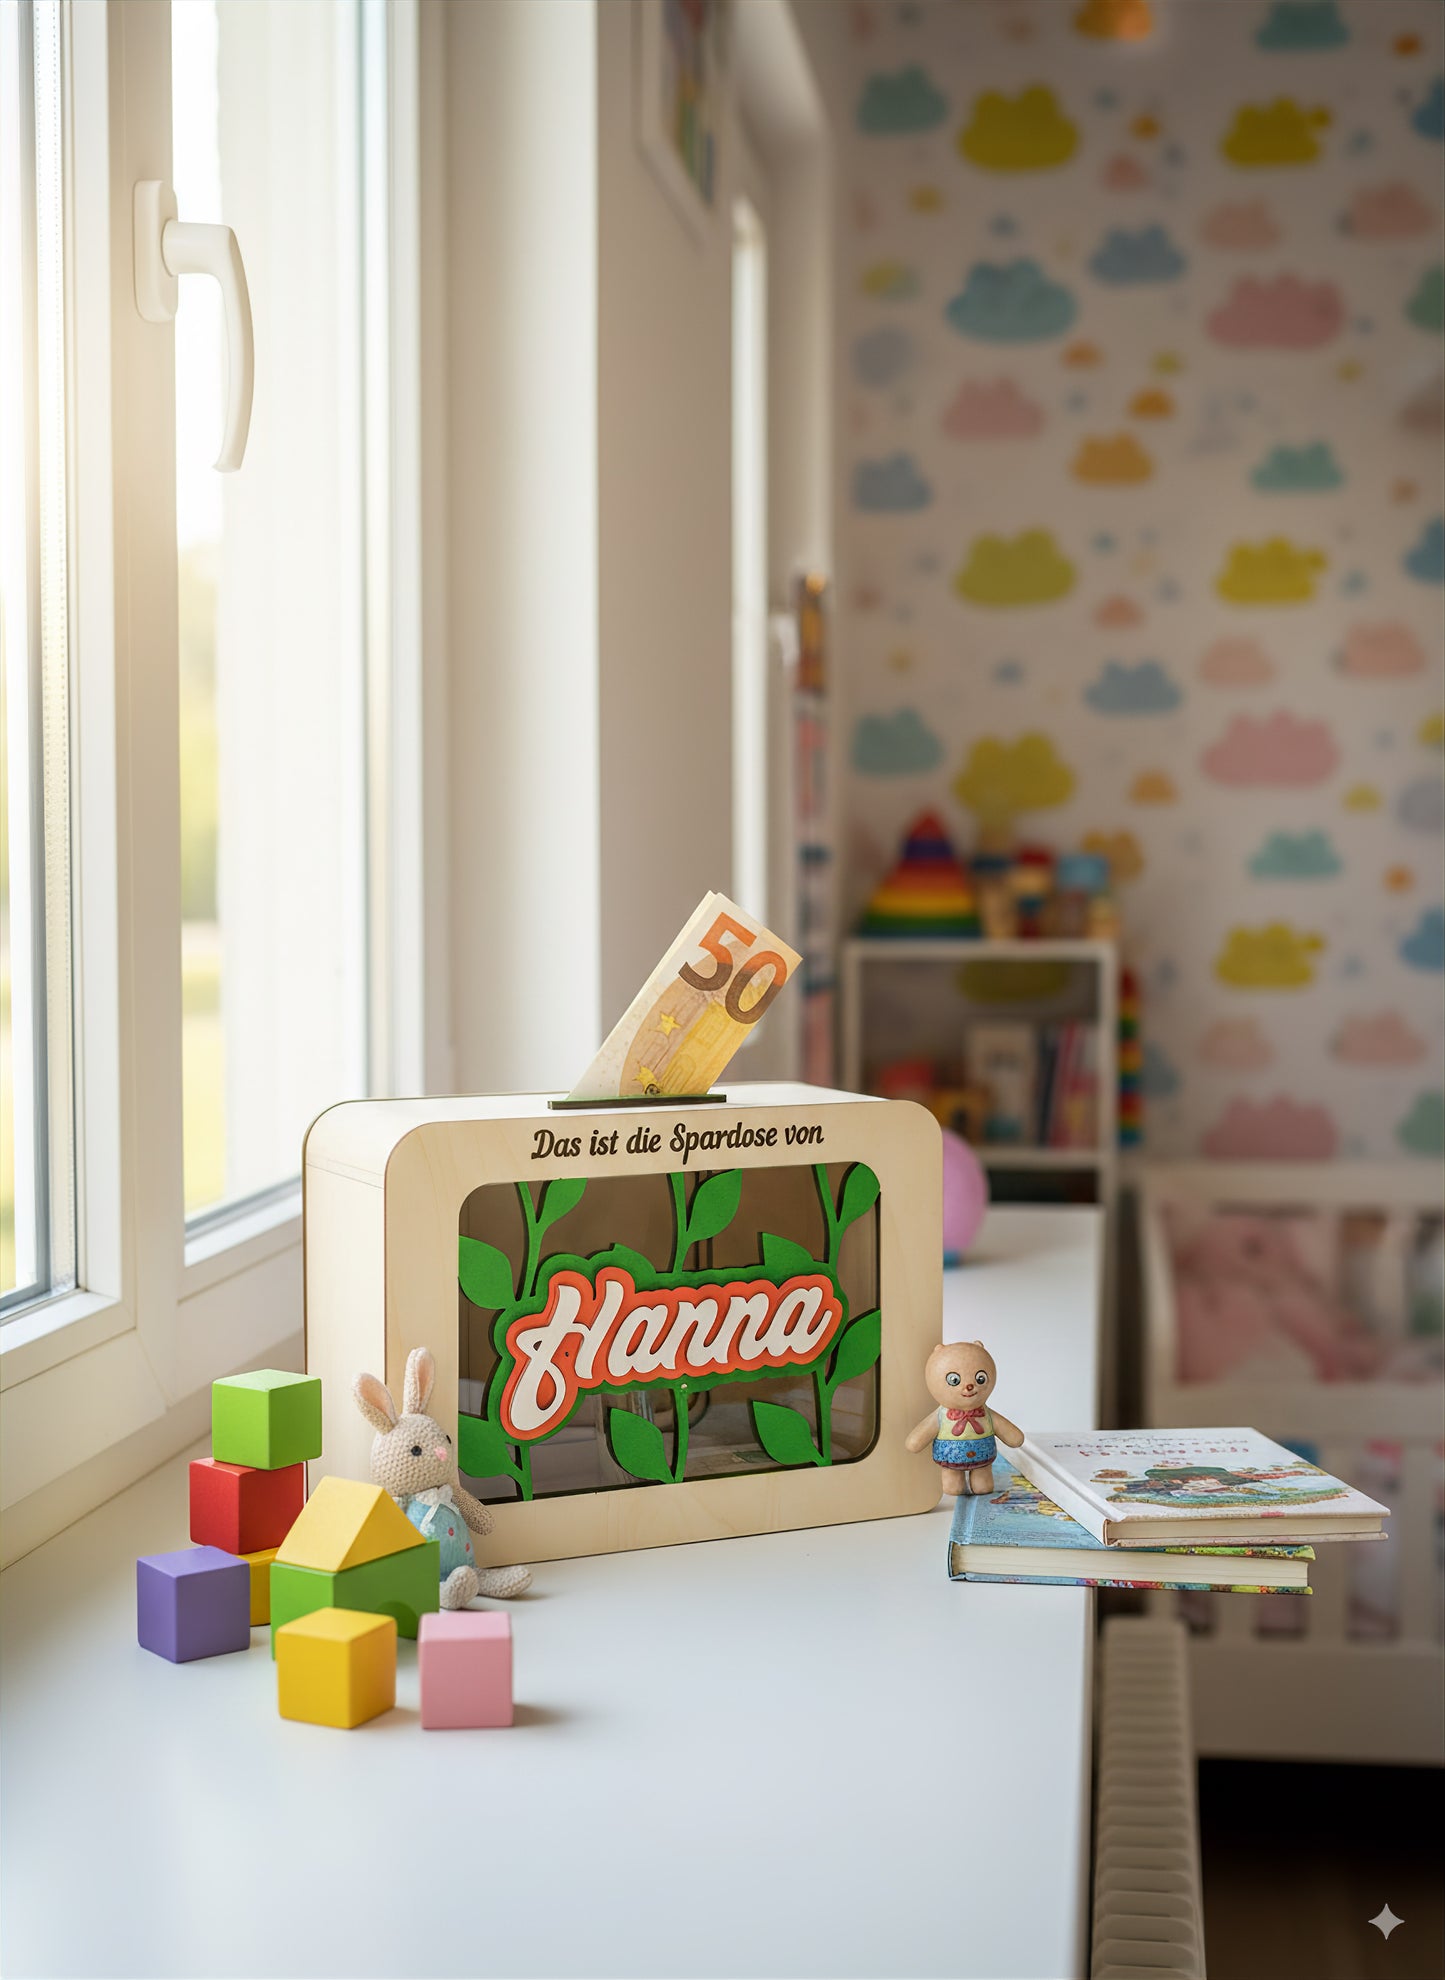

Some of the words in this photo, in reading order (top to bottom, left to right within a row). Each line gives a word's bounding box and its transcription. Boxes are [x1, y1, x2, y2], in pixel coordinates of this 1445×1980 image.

[677, 911, 788, 1025] 50
[531, 1128, 582, 1160] Das
[589, 1128, 619, 1156] ist
[626, 1126, 661, 1154] die
[669, 1121, 778, 1165] Spardose
[785, 1124, 825, 1146] von
[510, 1280, 833, 1431] Hanna
